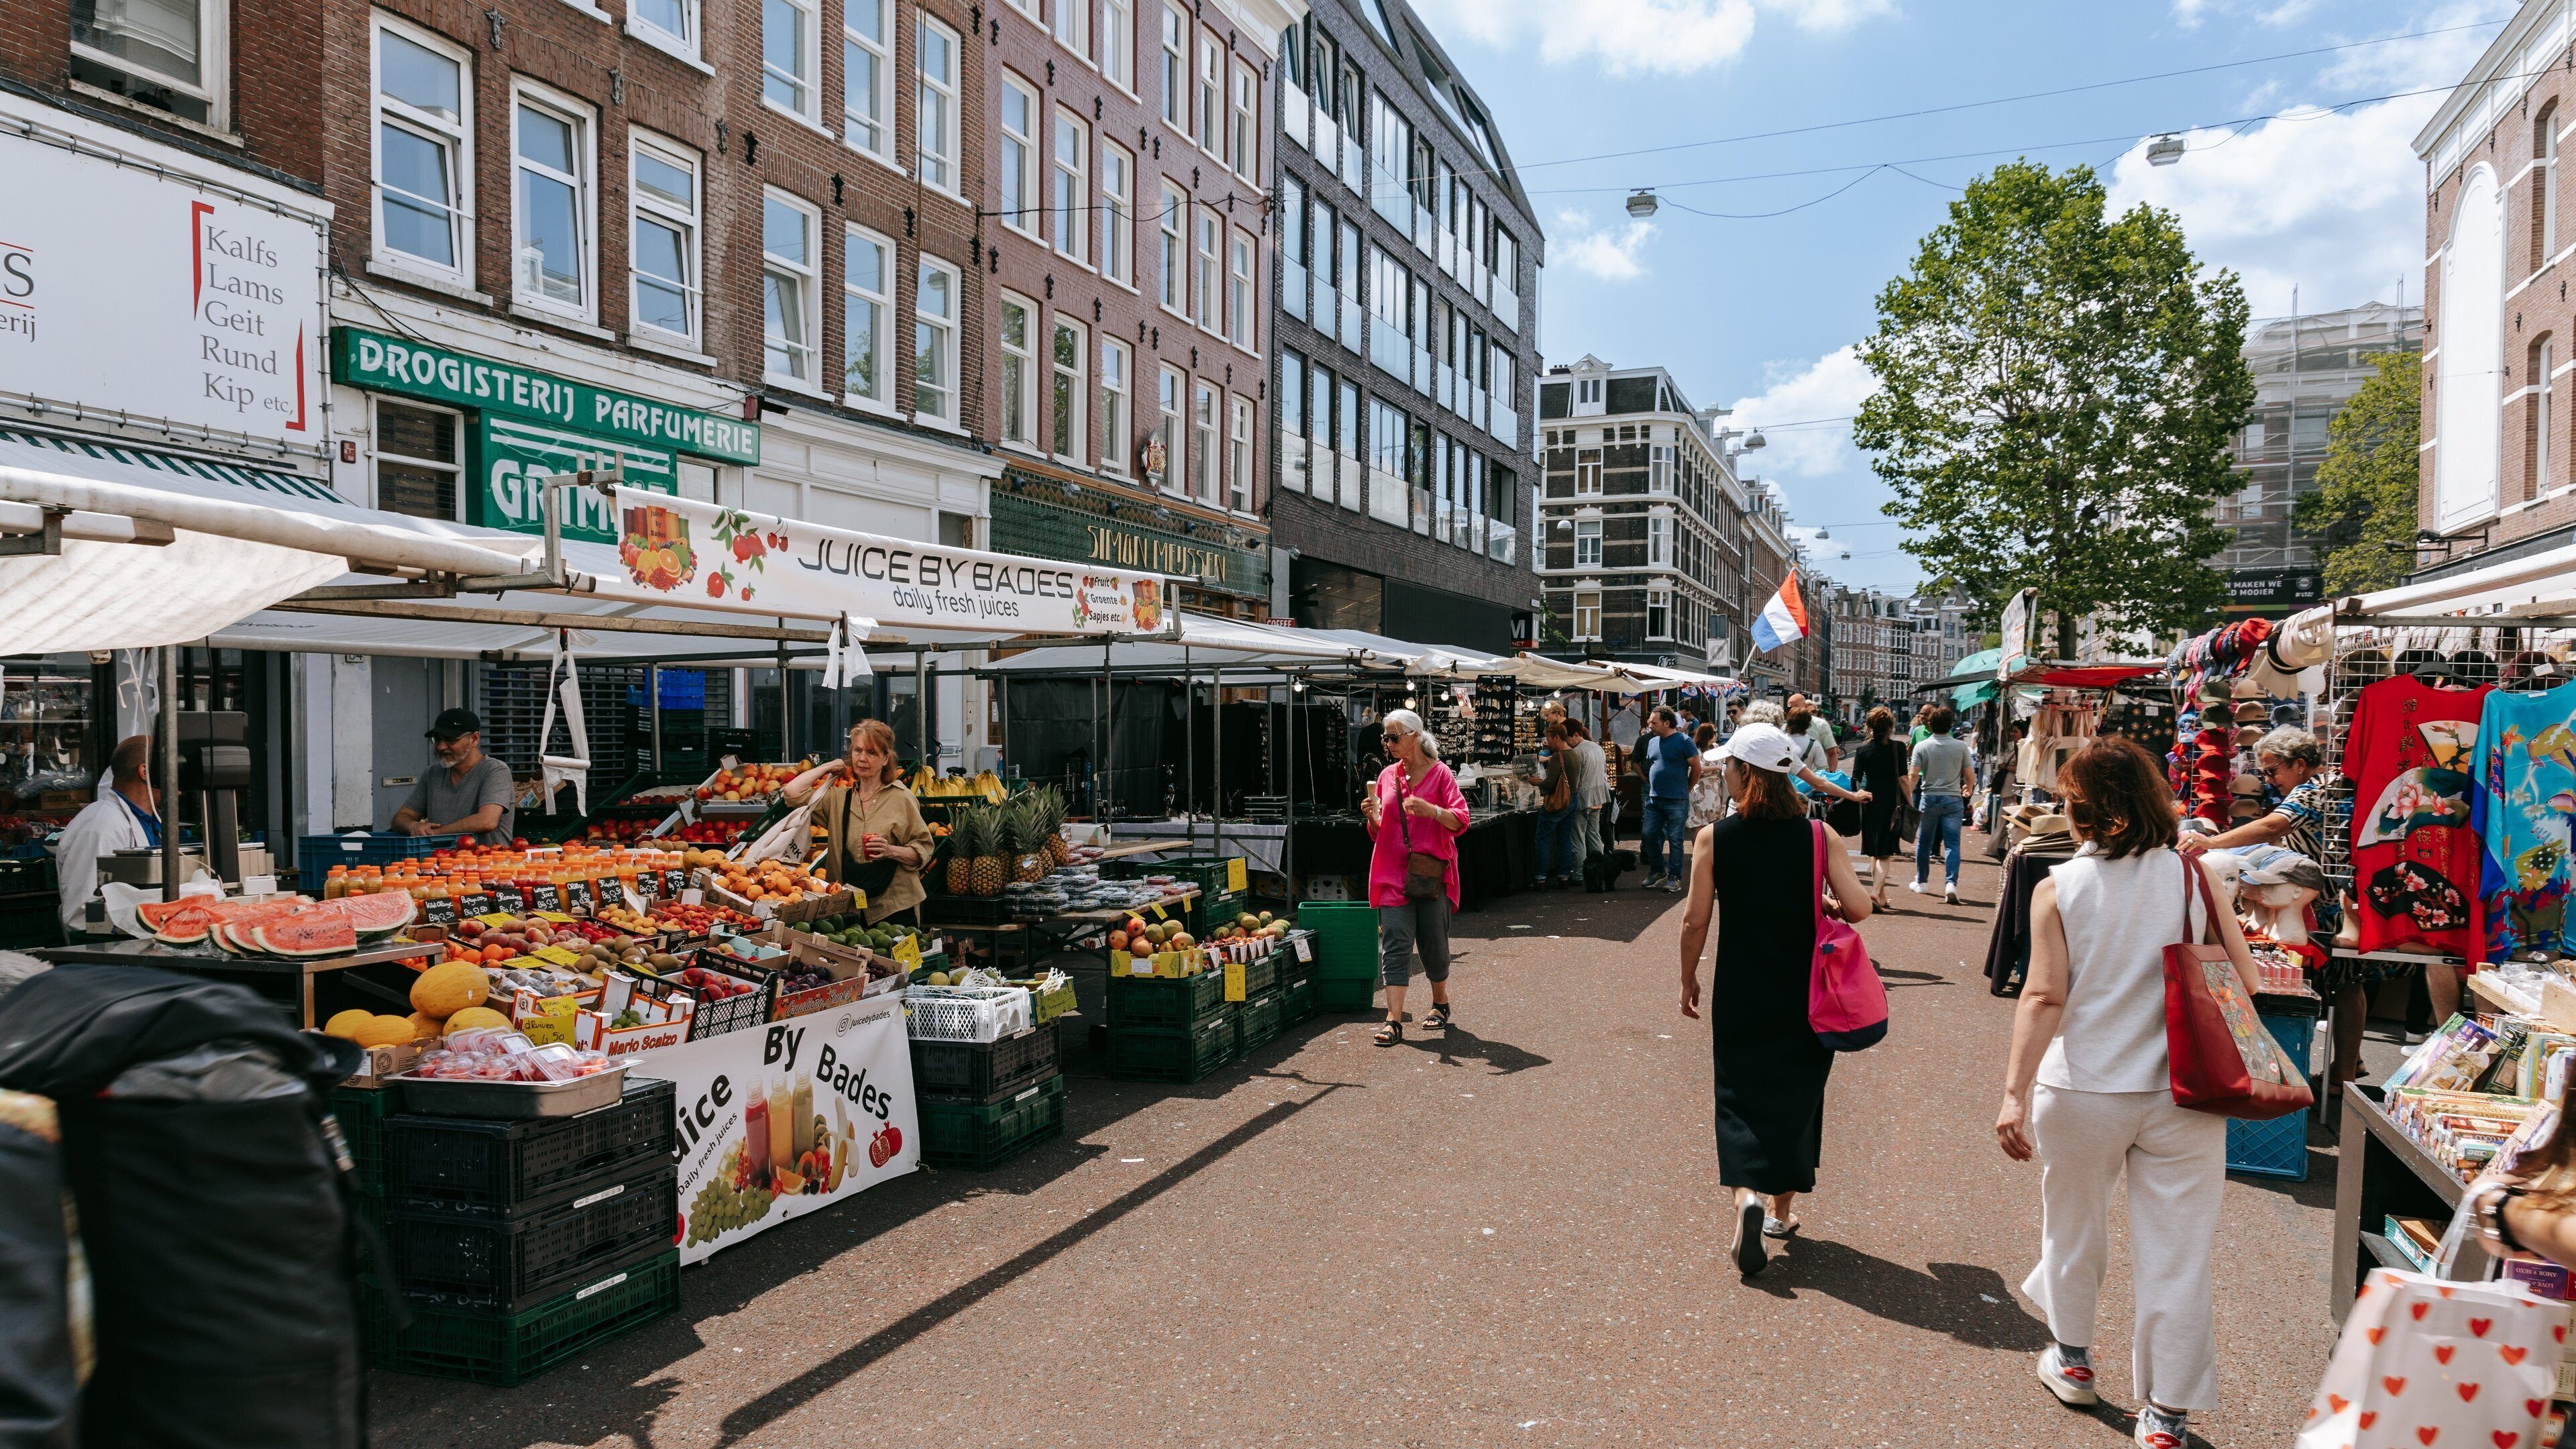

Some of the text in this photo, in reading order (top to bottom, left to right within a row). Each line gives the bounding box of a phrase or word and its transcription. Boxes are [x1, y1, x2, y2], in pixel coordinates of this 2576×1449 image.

[206, 225, 277, 268] Kalfs
[208, 263, 284, 306] Lams
[205, 301, 265, 336] Geit
[201, 335, 278, 375] Rund
[203, 372, 254, 415] Kip
[359, 338, 753, 455] DROGISTERIJ PARFUMERIE
[650, 509, 663, 518] Juice
[655, 521, 662, 529] by
[1087, 525, 1148, 568] SIMON
[798, 539, 1073, 598] JUICE BY BADES
[1095, 577, 1110, 587] Fruit
[894, 584, 1019, 619] daily fresh juices
[1089, 613, 1121, 624] Sapjes etc.
[1091, 594, 1118, 605] Groente
[429, 914, 440, 923] Big
[608, 1038, 638, 1057] Mario
[641, 1032, 677, 1049] Scalzo
[763, 1025, 806, 1073] By
[816, 1043, 892, 1121] Bades
[678, 1112, 738, 1196] Daily fresh juices
